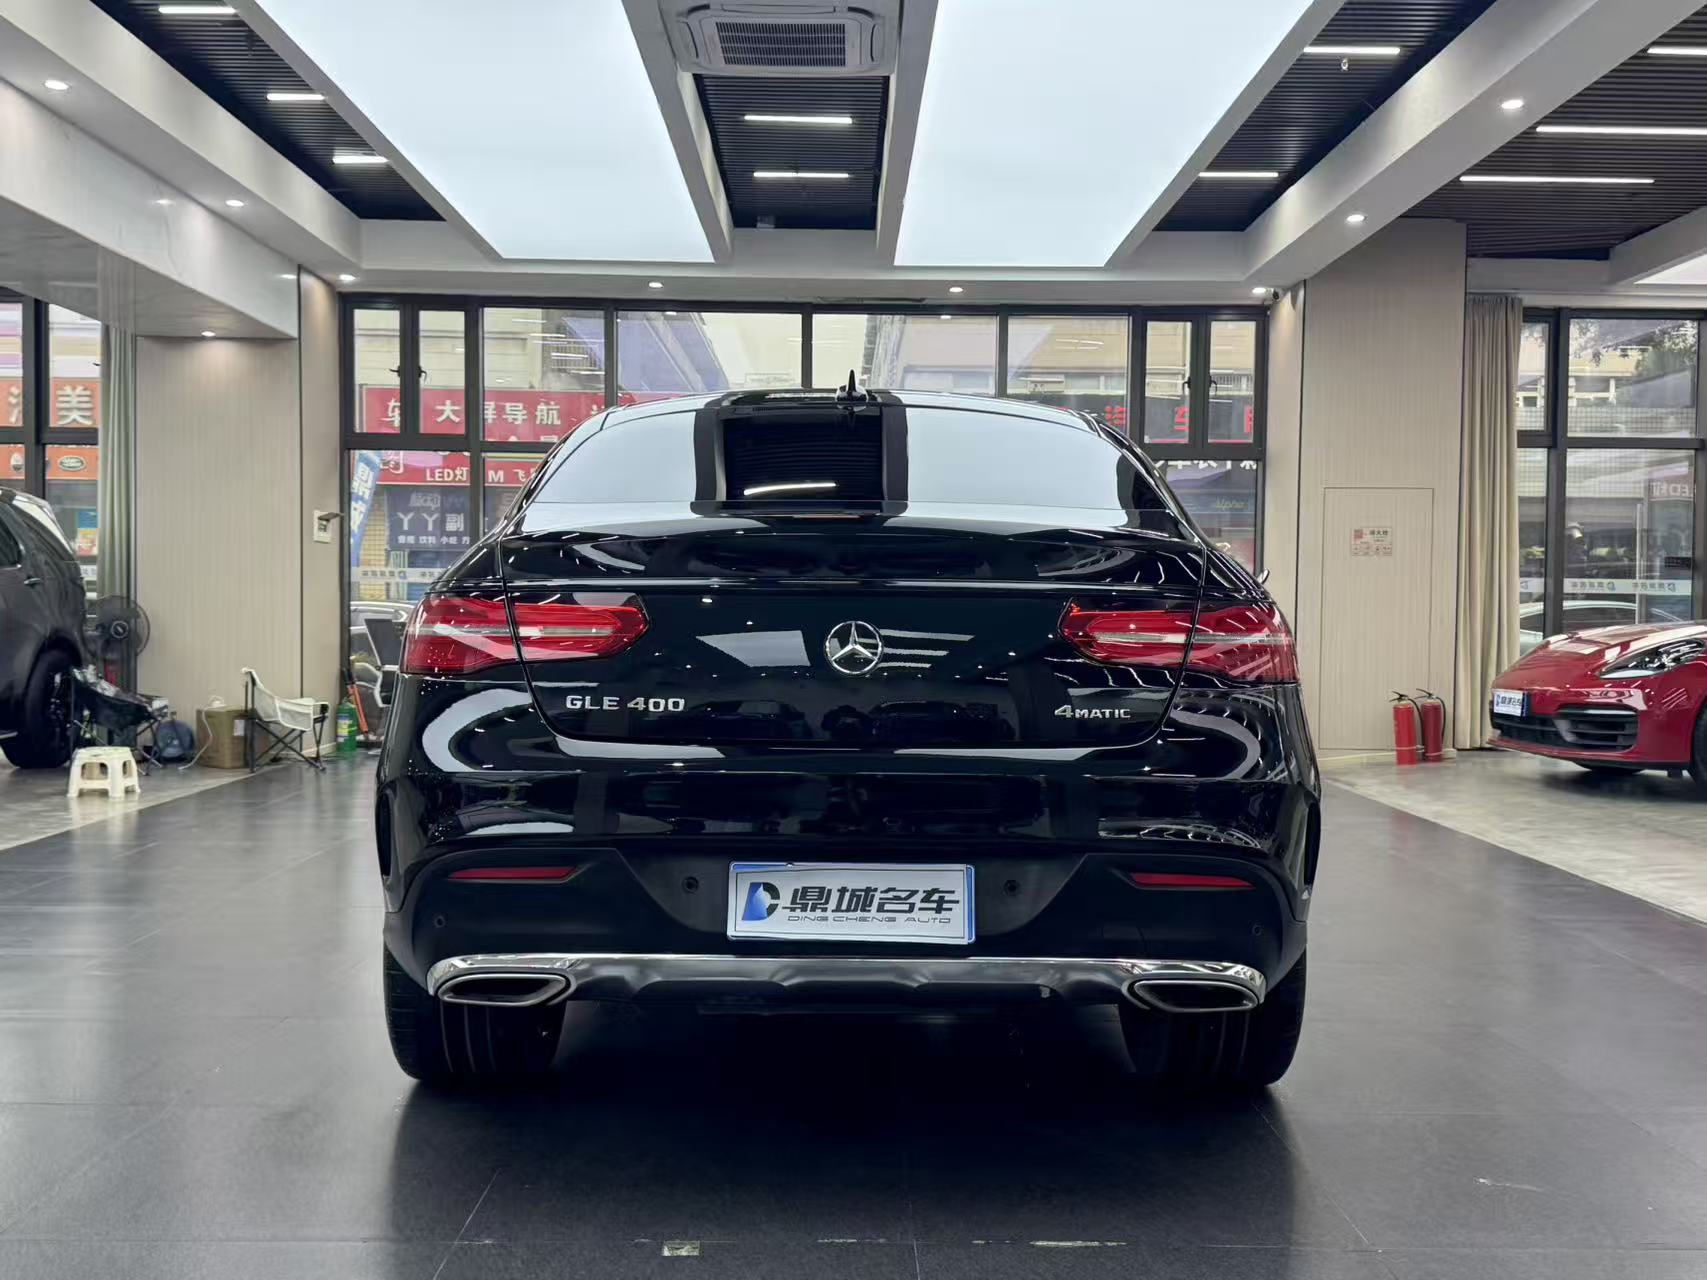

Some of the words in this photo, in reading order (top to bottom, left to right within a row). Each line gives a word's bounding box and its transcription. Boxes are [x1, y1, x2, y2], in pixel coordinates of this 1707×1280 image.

[426, 467, 469, 481] LED灯
[566, 695, 619, 710] GLE
[627, 697, 685, 712] 400
[782, 886, 960, 914] 鼎城名车
